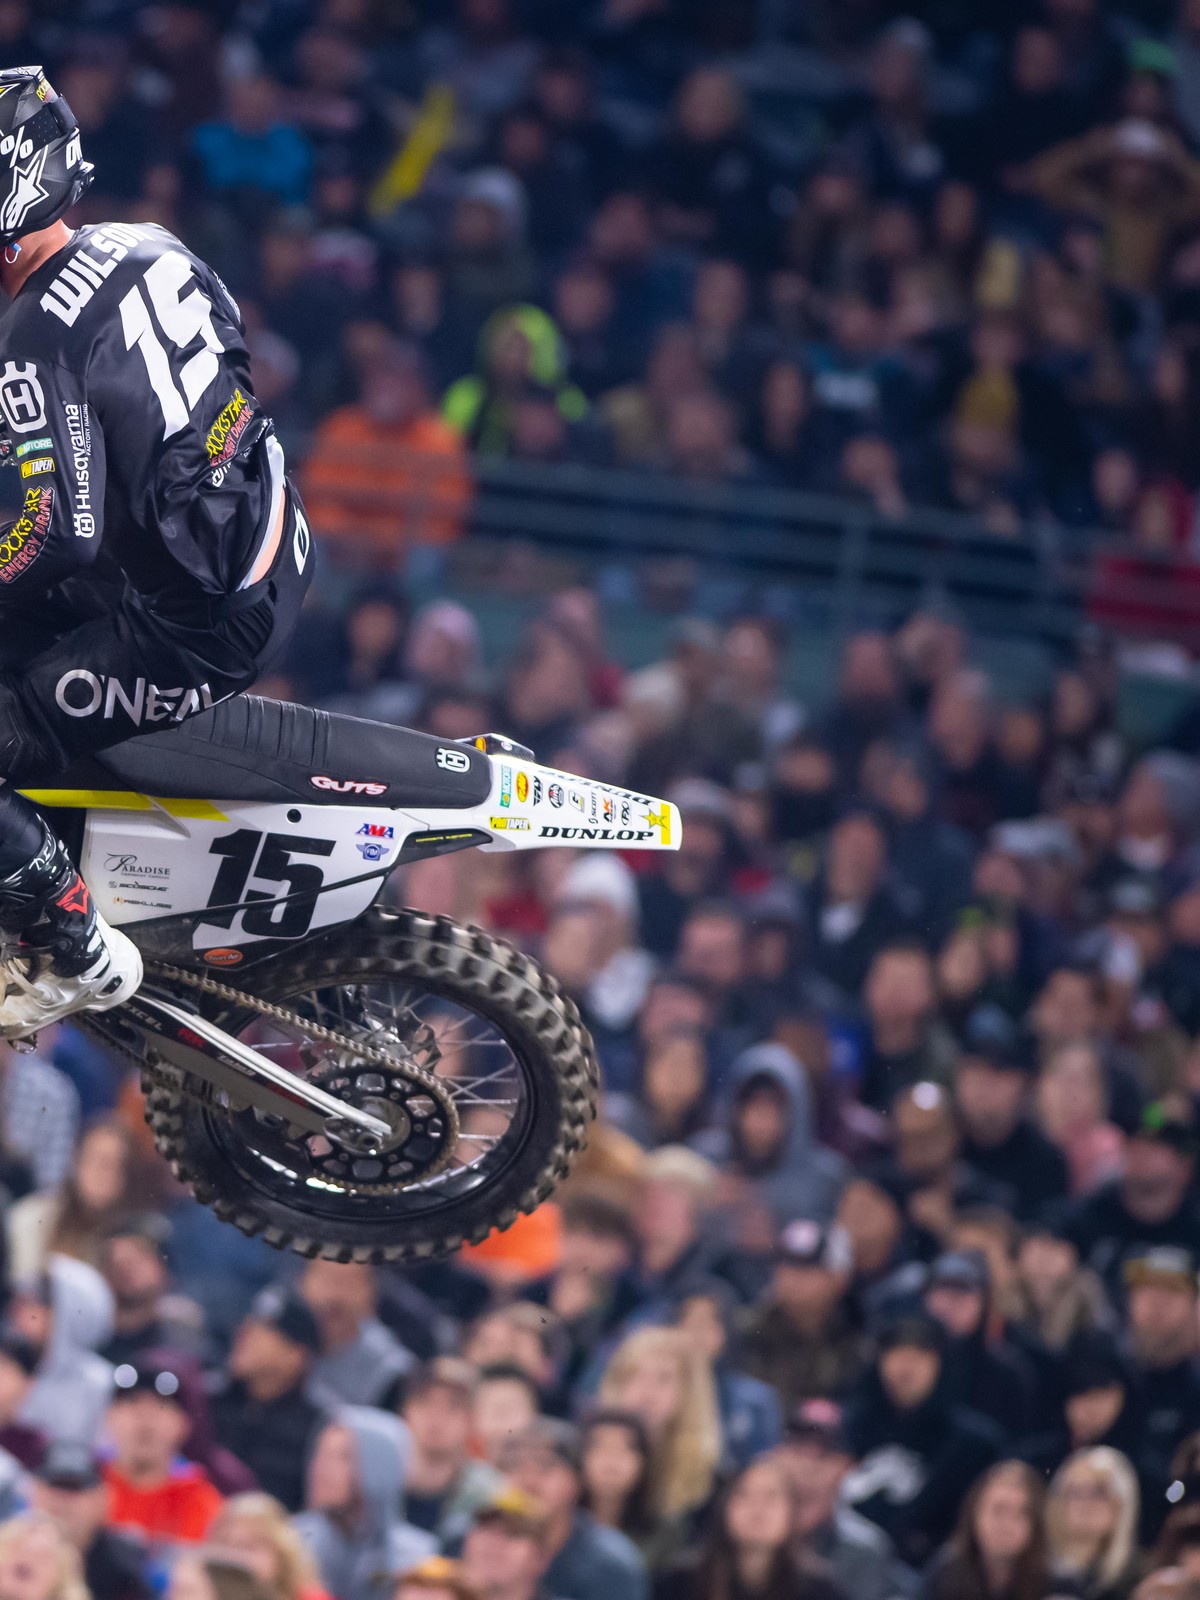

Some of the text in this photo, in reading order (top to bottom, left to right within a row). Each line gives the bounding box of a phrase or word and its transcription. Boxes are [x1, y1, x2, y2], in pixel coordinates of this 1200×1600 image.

[40, 222, 157, 327] WILSON
[119, 250, 225, 442] 15
[65, 404, 90, 510] Husqvarna
[0, 487, 53, 583] ENERGY DRINK
[311, 776, 388, 795] GUTS
[356, 823, 395, 839] AMA
[366, 848, 378, 856] FIM
[538, 826, 654, 841] DUNLOP
[104, 852, 171, 876] PARADISE
[206, 828, 337, 938] 15
